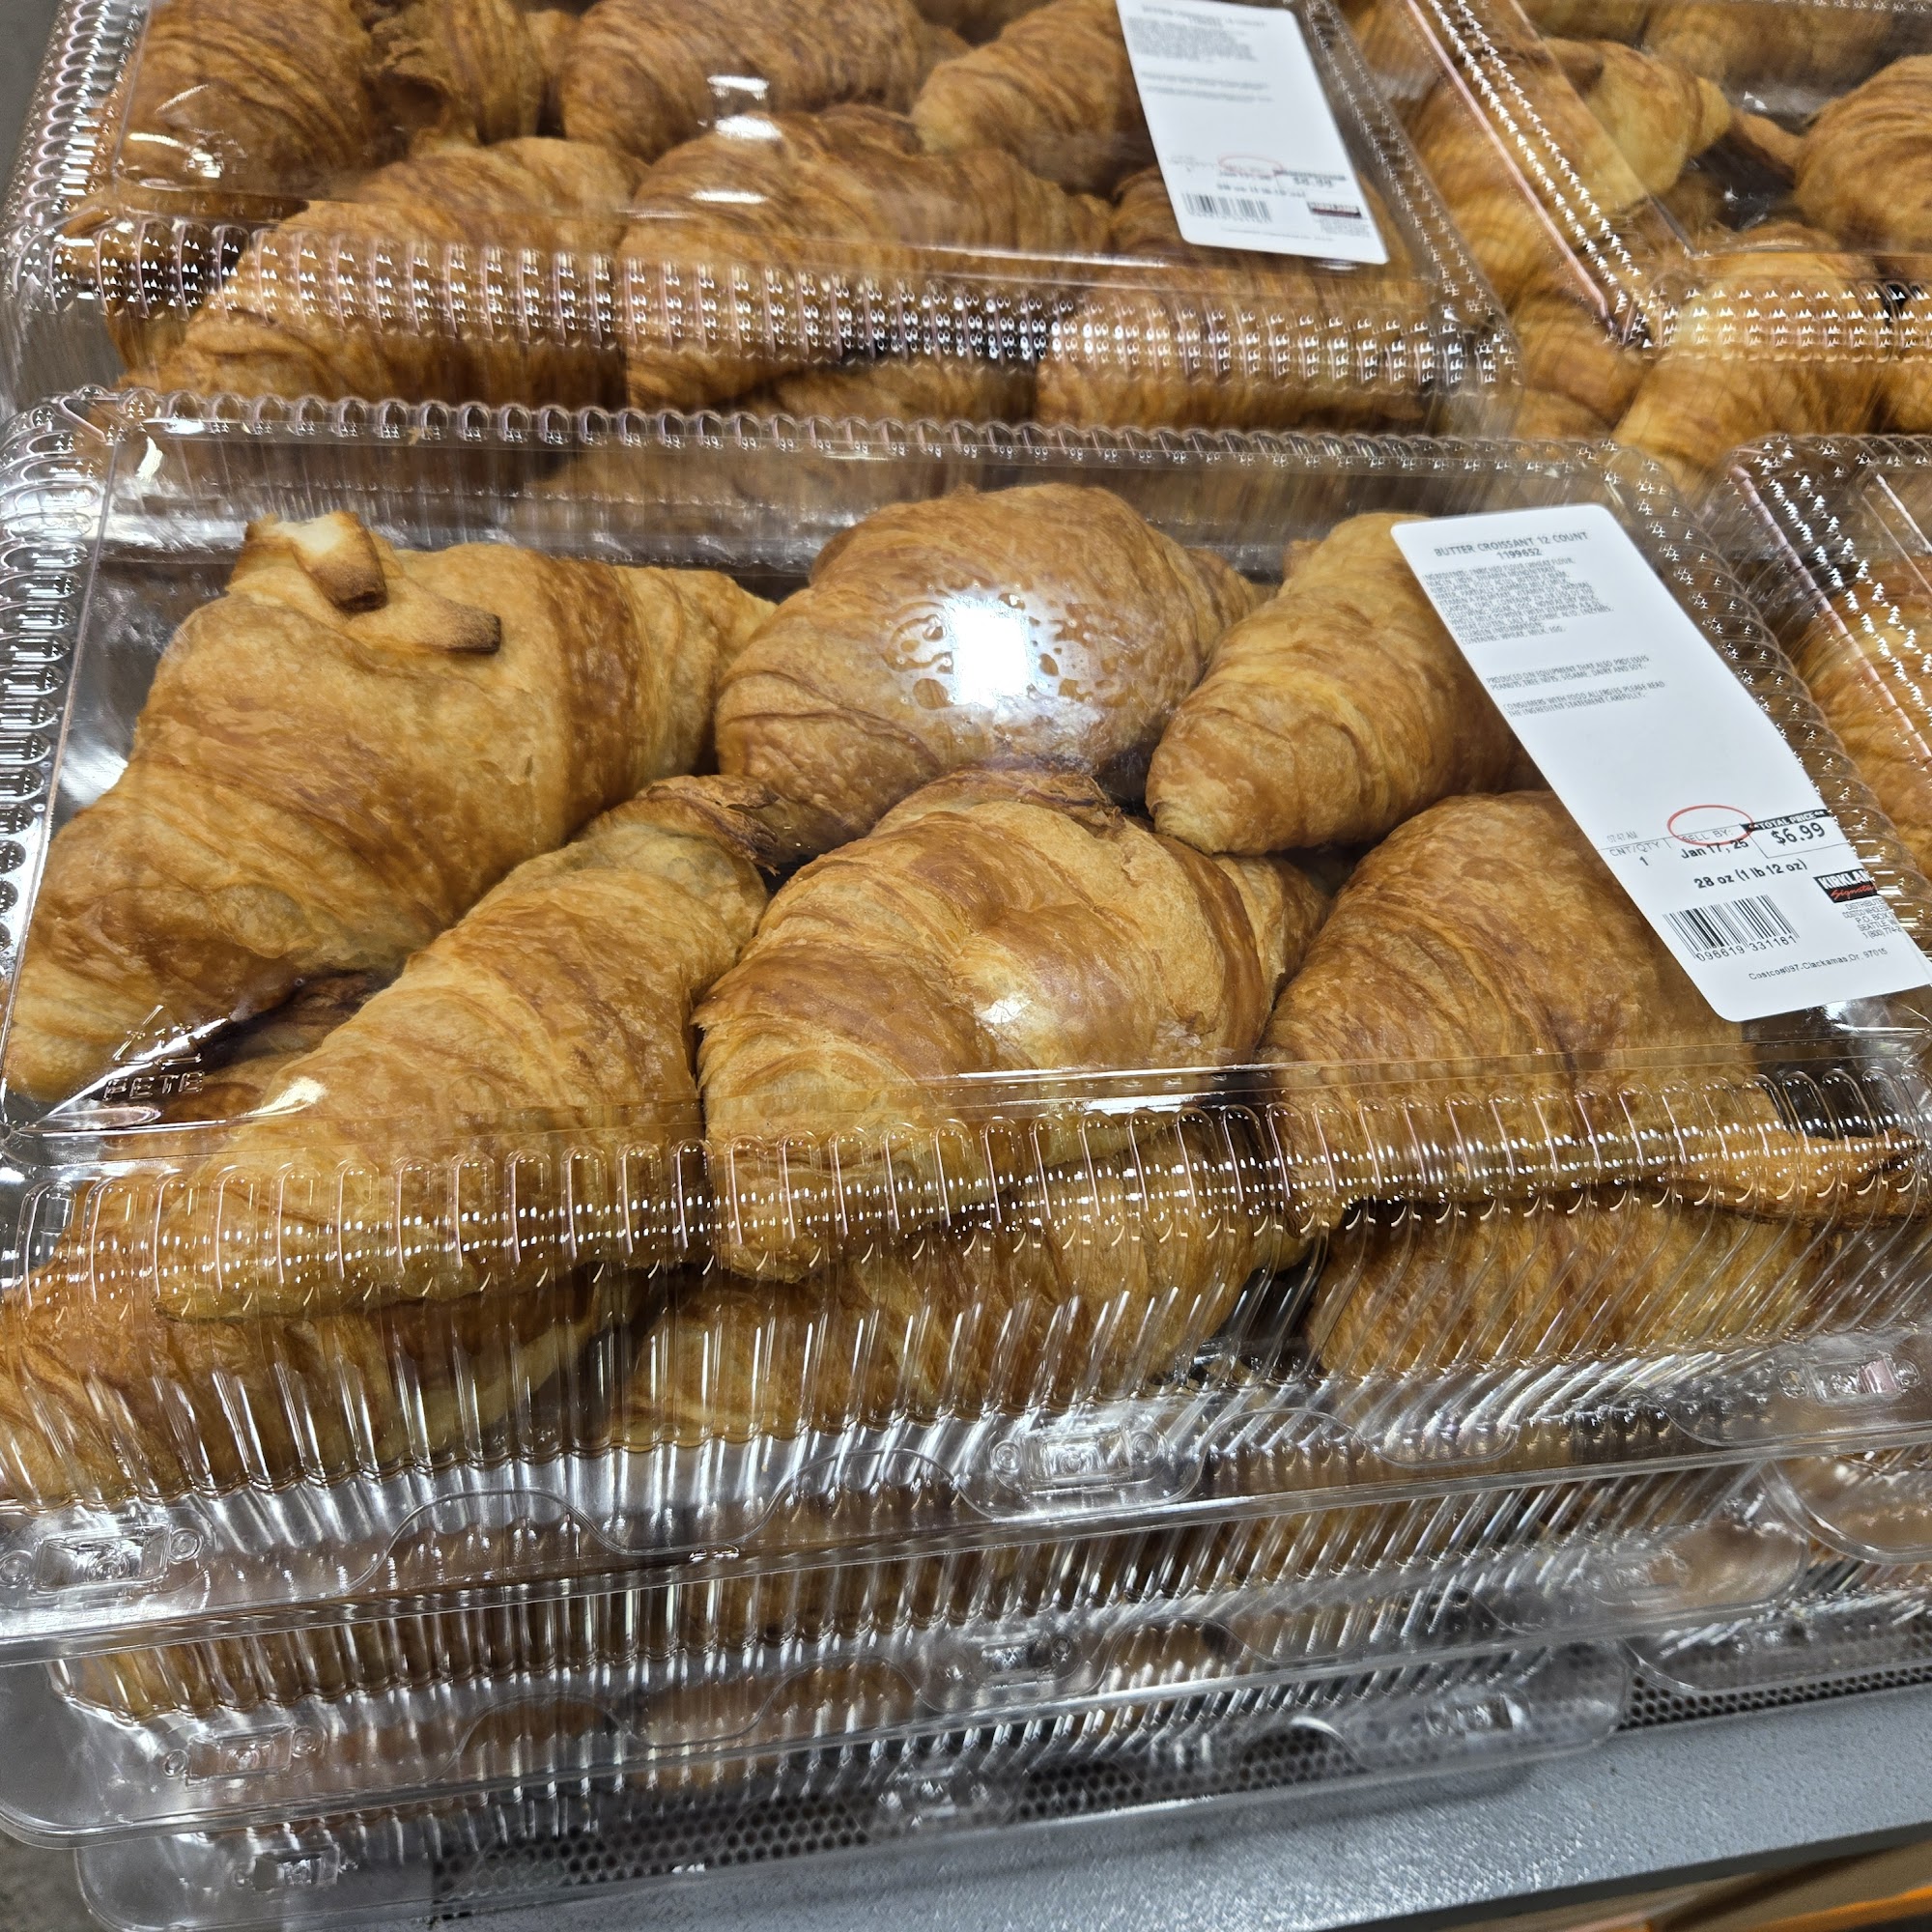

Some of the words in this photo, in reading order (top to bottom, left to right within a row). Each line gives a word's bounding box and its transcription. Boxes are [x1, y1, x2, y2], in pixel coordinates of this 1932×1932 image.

[1434, 545, 1476, 556] BUTTER
[1476, 539, 1535, 551] CROISSANT
[1551, 532, 1590, 542] COUNT
[1498, 549, 1543, 560] 1199652
[1682, 832, 1710, 843] SELL
[1770, 822, 1825, 846] $6.99
[1609, 840, 1662, 857] CNT/QTY
[1681, 847, 1707, 859] Jan
[1730, 838, 1749, 850] 25
[1639, 856, 1649, 867] 1
[1693, 876, 1715, 889] 28
[1717, 874, 1735, 884] oz
[1734, 868, 1749, 881] (1
[1749, 867, 1766, 878] lb
[1766, 864, 1784, 875] 12
[1786, 859, 1807, 872] oz)
[1864, 949, 1889, 958] 97015
